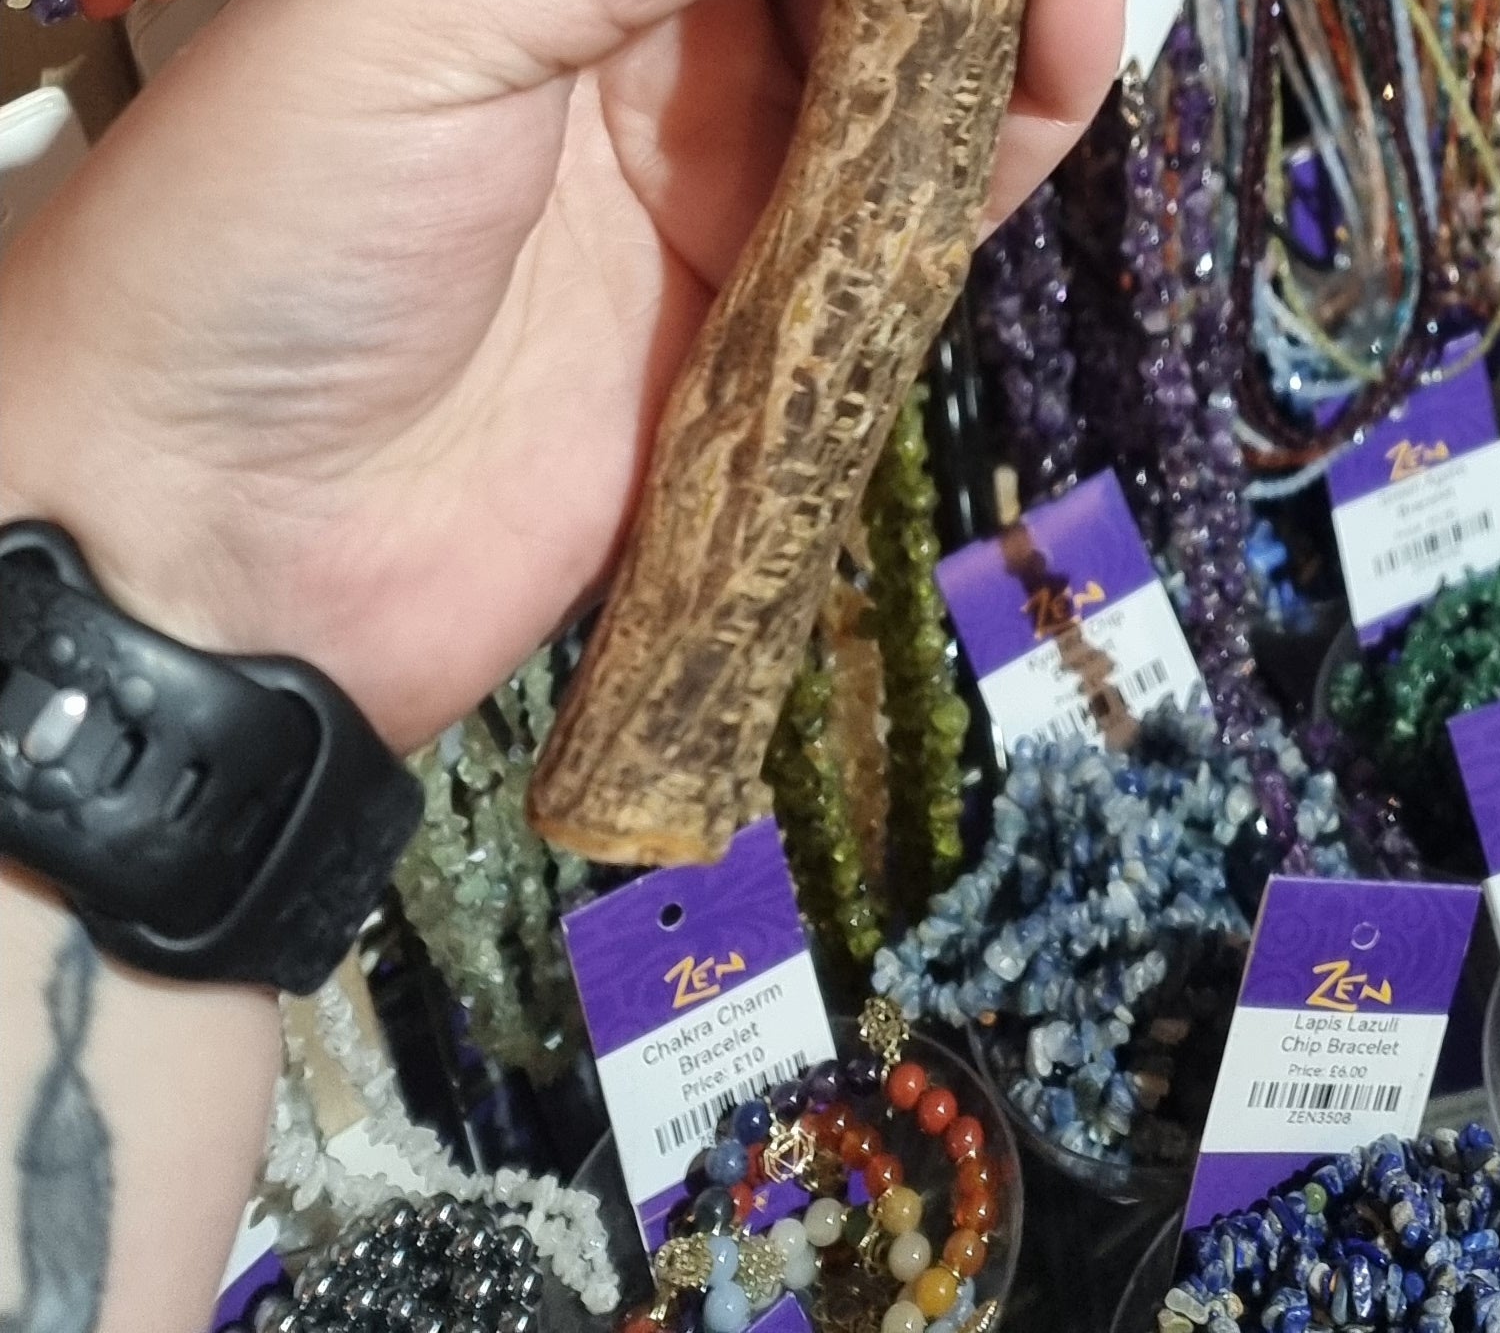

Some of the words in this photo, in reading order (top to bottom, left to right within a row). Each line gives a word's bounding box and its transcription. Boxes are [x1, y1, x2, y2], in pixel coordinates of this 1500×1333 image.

[1020, 581, 1107, 641] ZEN
[663, 951, 746, 1009] ZEN
[1305, 960, 1394, 1012] ZEN
[641, 1019, 714, 1067] Chakra
[716, 983, 785, 1026] Charm
[678, 1021, 761, 1076] Bracelet
[1280, 1035, 1322, 1057] Chip
[1326, 1037, 1400, 1056] Bracelet
[1294, 1013, 1342, 1034] Lapis
[1346, 1015, 1400, 1034] Lazuli
[731, 1045, 767, 1076] £10
[1327, 1065, 1369, 1079] £6.00
